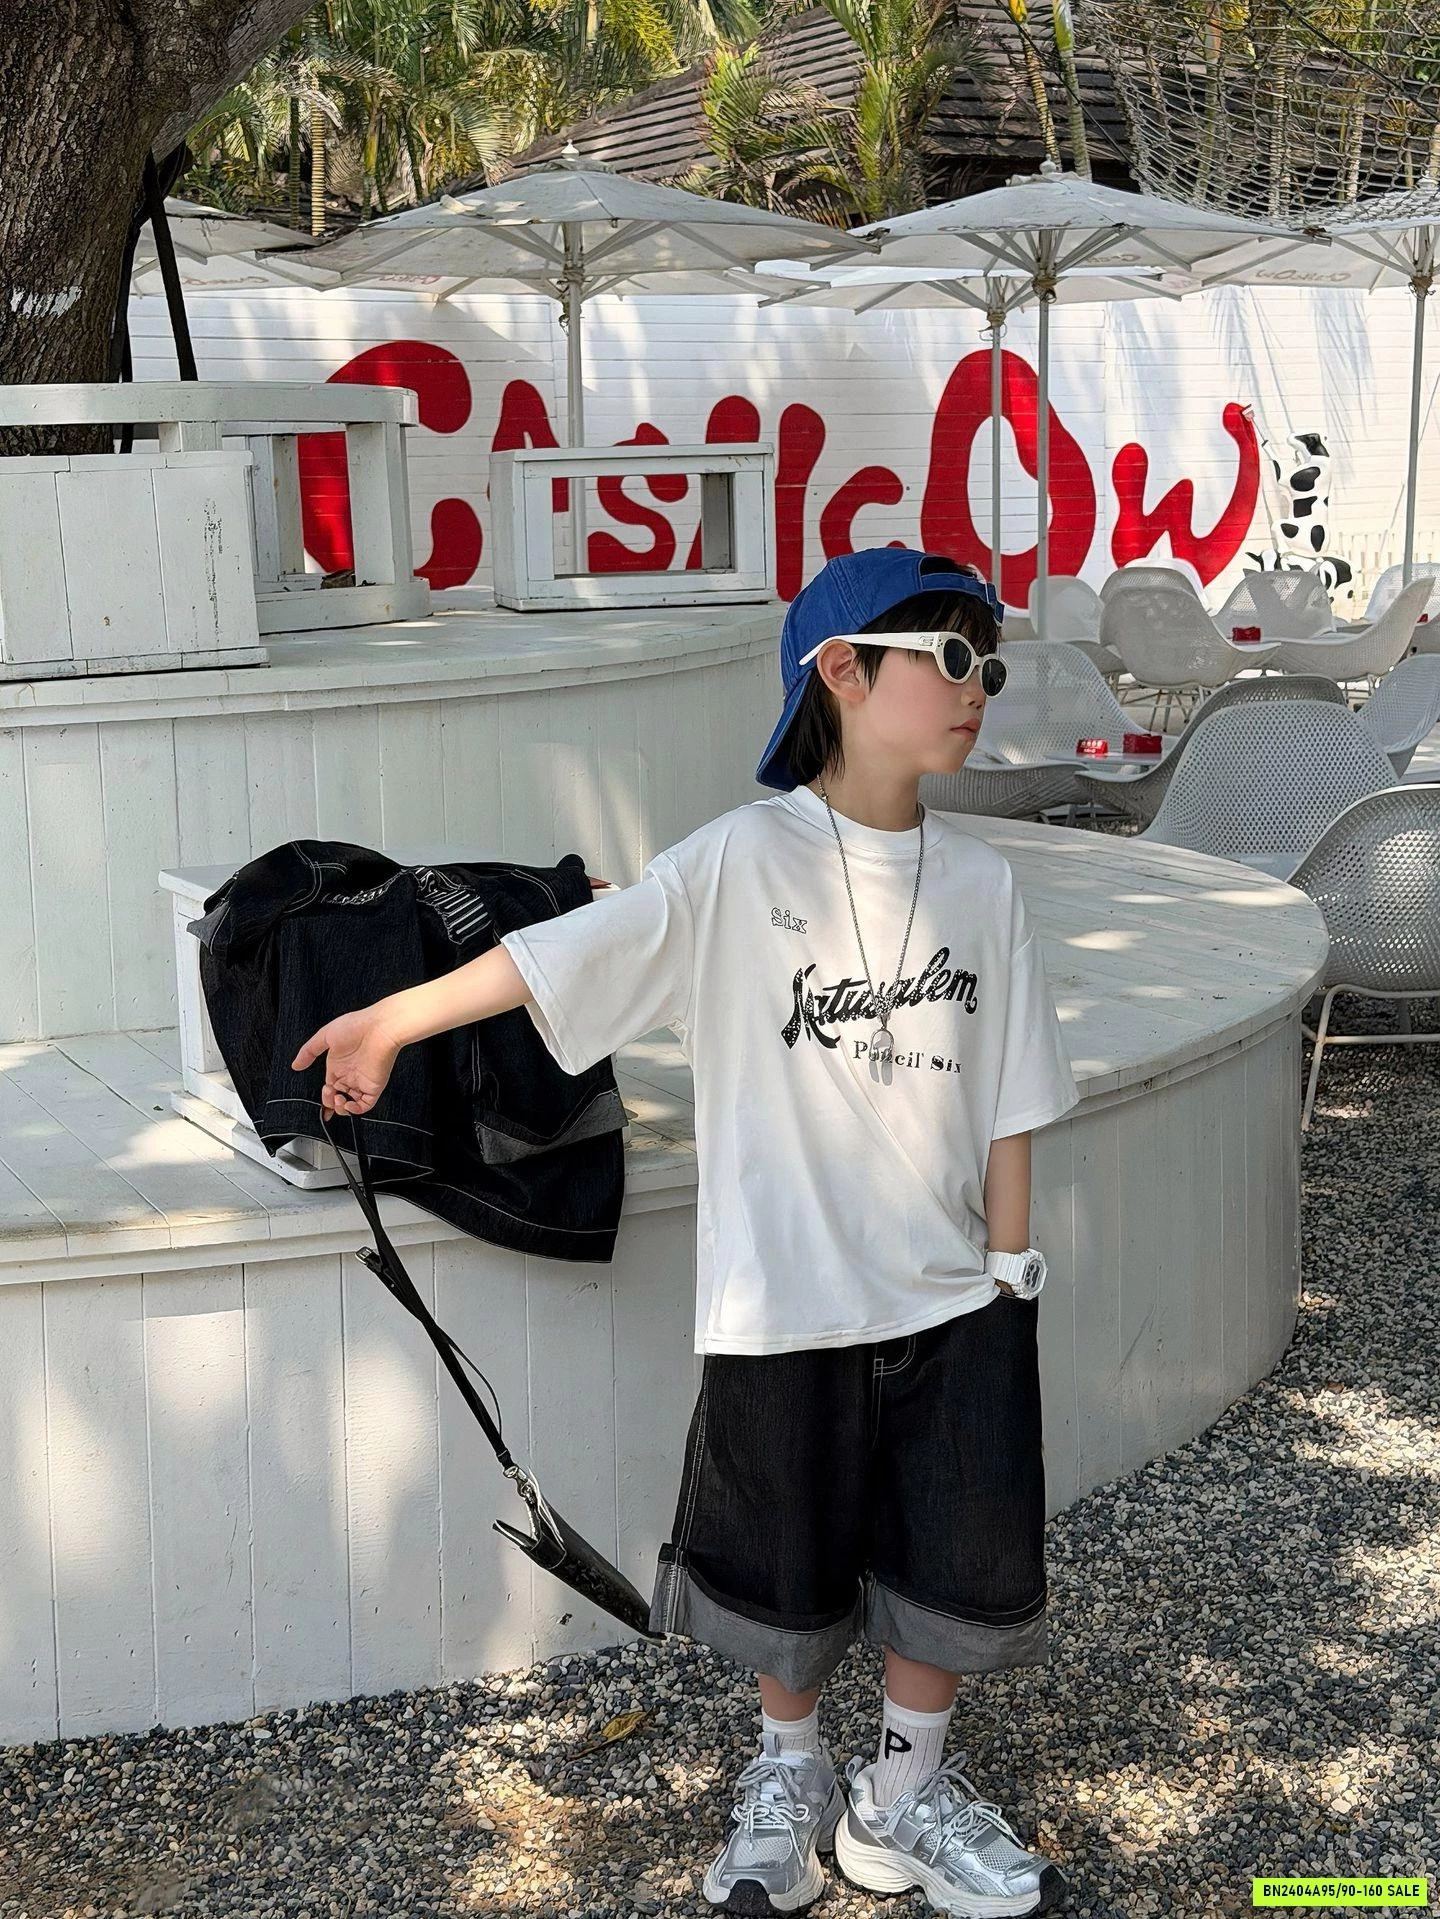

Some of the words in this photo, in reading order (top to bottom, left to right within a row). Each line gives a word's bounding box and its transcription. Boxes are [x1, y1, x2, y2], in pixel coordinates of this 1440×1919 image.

[771, 907, 808, 934] Six
[930, 1055, 963, 1074] Six
[884, 1727, 912, 1760] P
